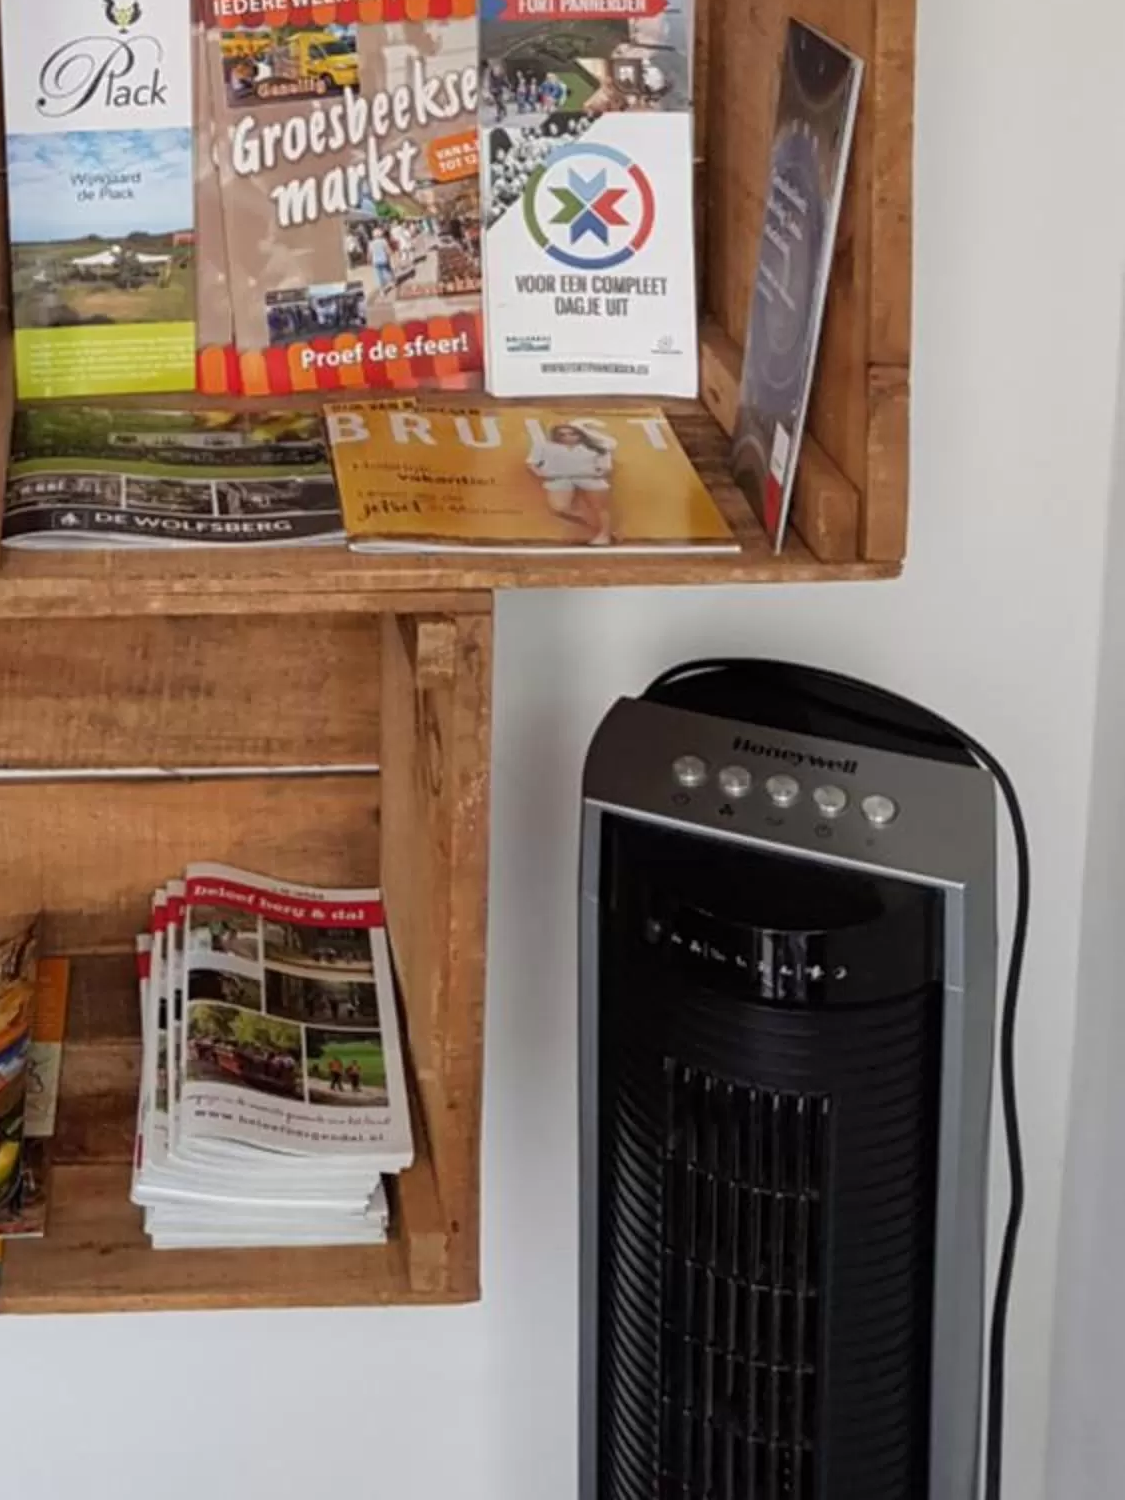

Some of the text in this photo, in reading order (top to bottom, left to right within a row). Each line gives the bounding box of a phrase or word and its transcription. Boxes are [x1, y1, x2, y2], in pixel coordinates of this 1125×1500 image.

[36, 35, 169, 118] Plack
[70, 171, 142, 187] Wijngaard
[271, 133, 420, 228] markt
[76, 187, 135, 201] de Plack
[515, 275, 667, 296] VOOR EEN COMPLEET
[554, 297, 629, 317] DAGJE UIT
[300, 332, 469, 369] Proef de sfeer!
[94, 512, 293, 533] DE WOLFSBERG
[732, 736, 859, 773] Honeywell
